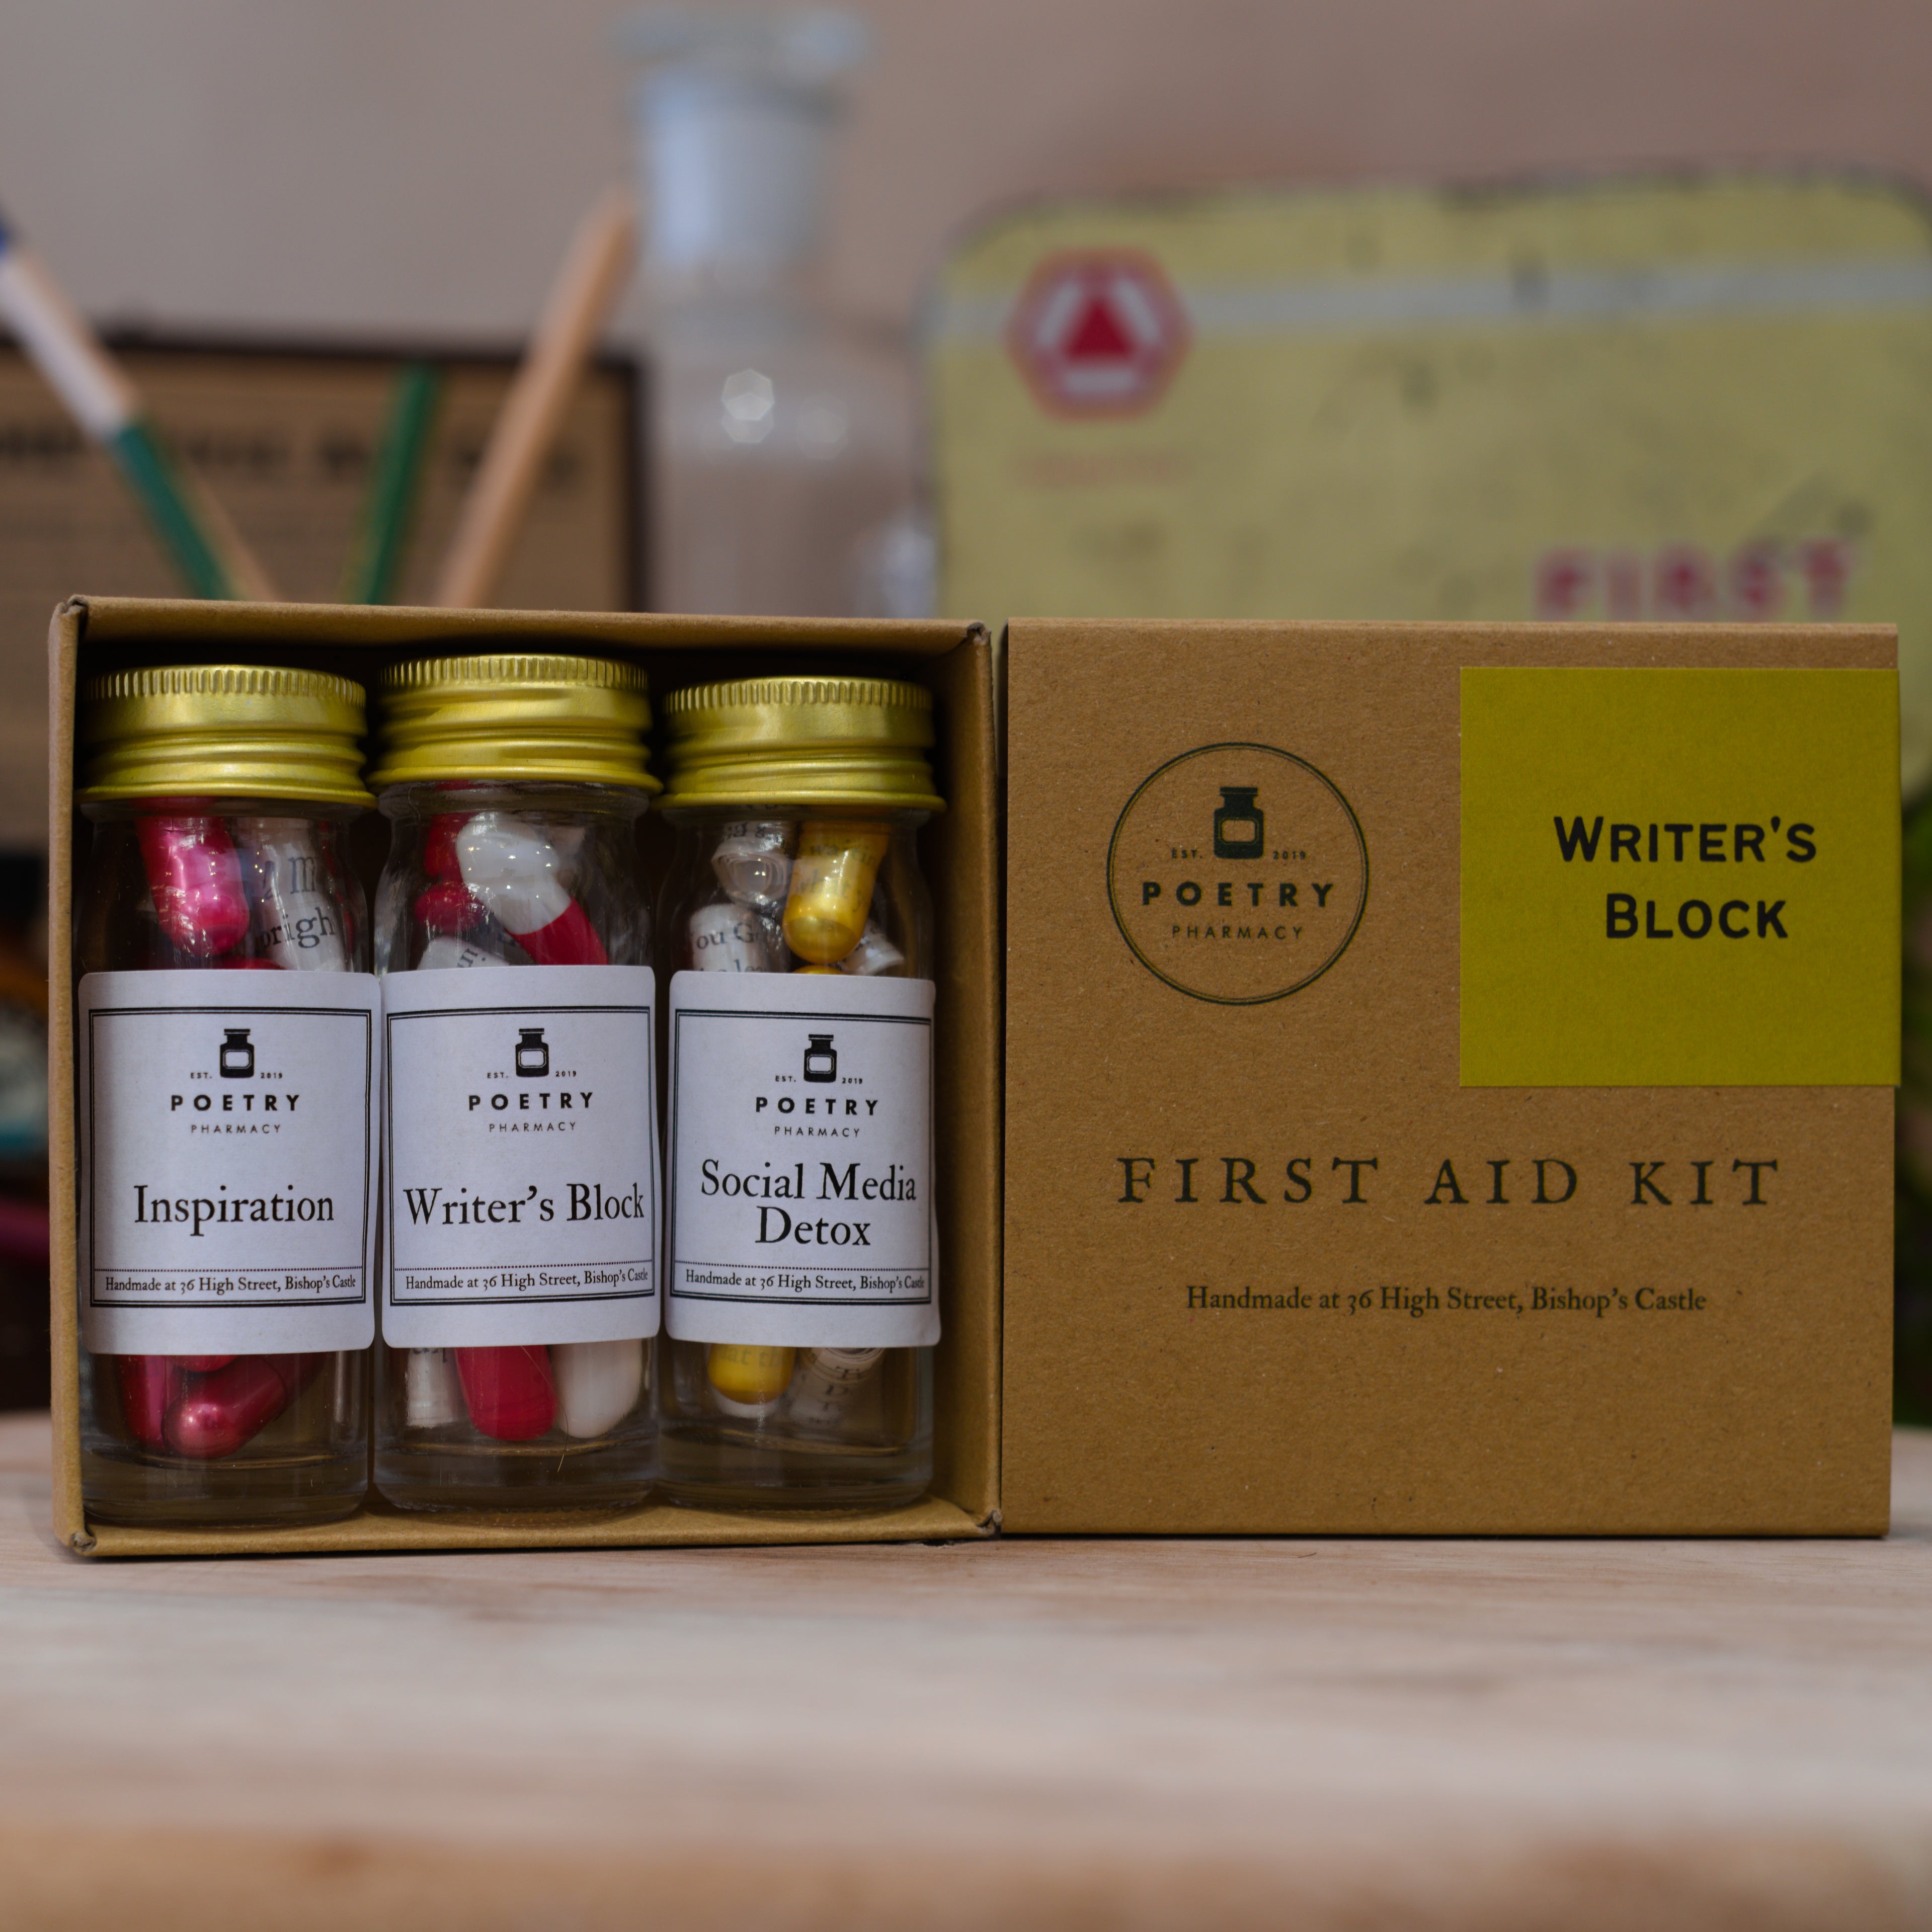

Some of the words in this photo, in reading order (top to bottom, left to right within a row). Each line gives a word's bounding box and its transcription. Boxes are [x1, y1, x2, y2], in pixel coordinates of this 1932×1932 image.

[1554, 816, 1816, 863] WRITER'S
[1171, 847, 1202, 859] EST.
[1273, 850, 1306, 860] 2019
[1142, 881, 1333, 908] POETRY
[1606, 893, 1788, 939] BLOCK
[1172, 925, 1302, 940] PHARMACY
[171, 1094, 299, 1111] POETRY
[469, 1092, 593, 1111] POETRY
[756, 1097, 878, 1116] POETRY
[191, 1123, 280, 1134] PHARMACY
[489, 1121, 576, 1132] PHARMACY
[774, 1126, 860, 1138] PHARMACY
[701, 1159, 805, 1199] Social
[816, 1162, 917, 1201] Media
[1116, 1157, 1378, 1204] FIRST
[1424, 1159, 1577, 1205] AID
[1629, 1159, 1778, 1205] KIT
[133, 1184, 334, 1237] Inspiration
[403, 1185, 554, 1225] Writer's
[567, 1182, 645, 1221] Block
[755, 1206, 870, 1246] Detox
[105, 1276, 161, 1292] Handmade
[165, 1281, 176, 1291] at
[180, 1279, 195, 1294] 36
[199, 1277, 234, 1296] High
[238, 1277, 281, 1293] Street,
[285, 1275, 330, 1294] Bishop's
[332, 1274, 356, 1288] Castle
[406, 1275, 463, 1290] Handmade
[467, 1278, 478, 1288] at
[482, 1275, 498, 1291] 36
[501, 1273, 535, 1292] High
[539, 1272, 581, 1287] Street,
[584, 1269, 626, 1287] Bishop's
[627, 1268, 648, 1281] Castle
[685, 1269, 742, 1286] Handmade
[745, 1277, 756, 1286] at
[760, 1275, 775, 1290] 36
[778, 1274, 811, 1293] High
[815, 1275, 856, 1292] Street,
[860, 1275, 903, 1294] Bishop's
[904, 1275, 925, 1289] Castle
[1186, 1285, 1312, 1309] Handmade
[1319, 1293, 1340, 1309] at
[1347, 1290, 1374, 1315] 36
[1380, 1286, 1439, 1318] High
[1447, 1286, 1523, 1314] Street,
[1531, 1286, 1628, 1318] Bishop's
[1635, 1287, 1707, 1311] Castle
